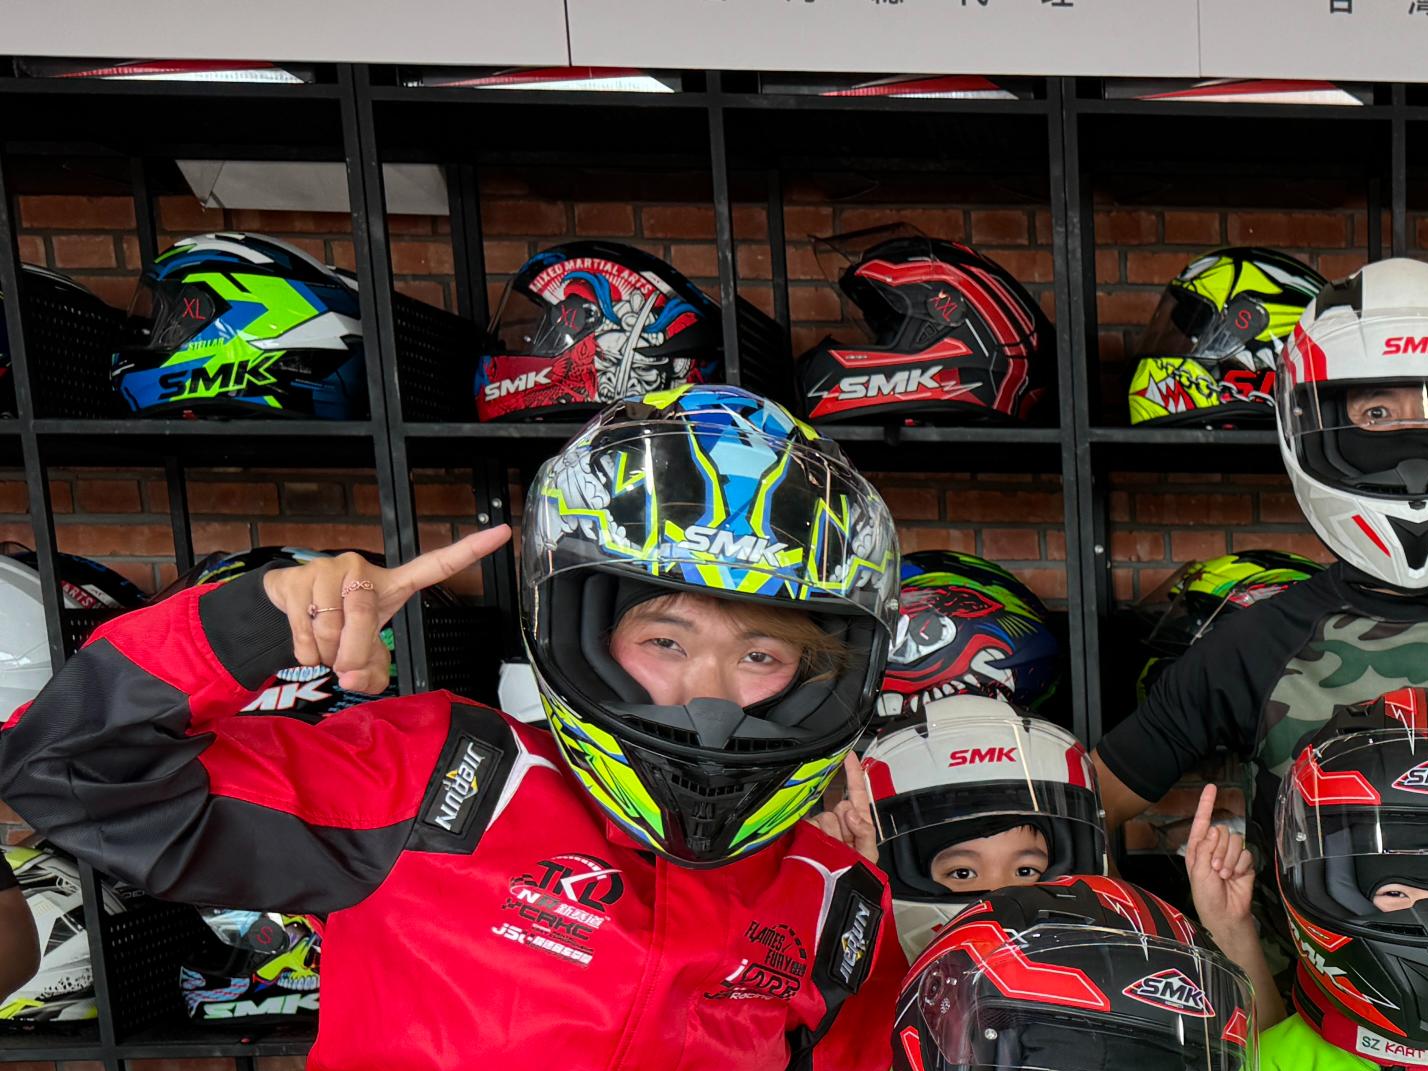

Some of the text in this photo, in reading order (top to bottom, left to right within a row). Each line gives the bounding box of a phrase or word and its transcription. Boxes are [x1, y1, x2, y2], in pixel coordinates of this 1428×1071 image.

[529, 258, 652, 294] MIXED MARTIAL ARTS
[182, 298, 206, 320] XL
[560, 304, 579, 330] XL
[929, 288, 958, 322] XXL
[1235, 310, 1252, 330] S
[187, 337, 225, 351] STELLAR
[158, 350, 287, 400] SMK
[484, 367, 553, 402] SMK
[838, 365, 943, 400] SMK
[677, 525, 789, 568] SMK
[63, 583, 94, 606] ARTS
[948, 747, 1017, 768] SMK
[257, 926, 274, 945] S
[1138, 977, 1205, 1008] SMK
[203, 993, 320, 1020] SMK
[1361, 1035, 1426, 1059] SZ KART
